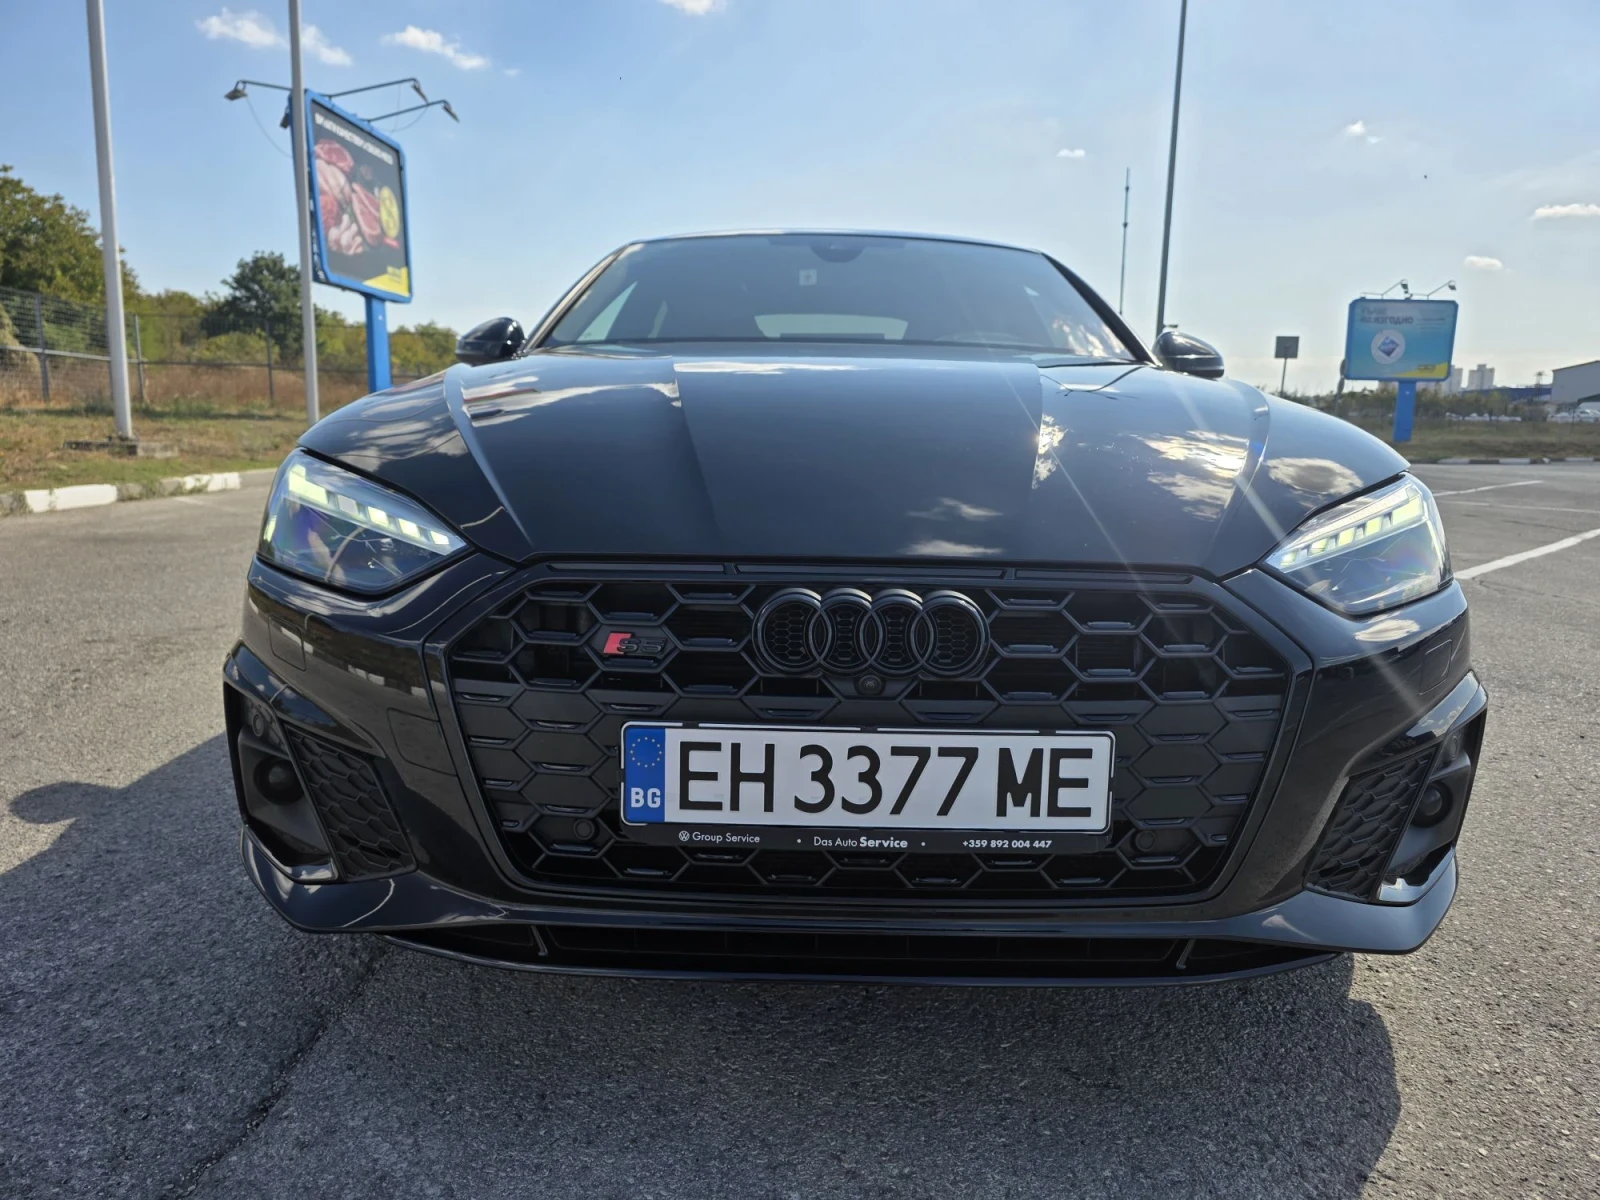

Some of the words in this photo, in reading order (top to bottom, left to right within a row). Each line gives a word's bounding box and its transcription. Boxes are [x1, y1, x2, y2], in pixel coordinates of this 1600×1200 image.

[617, 635, 668, 655] S5
[679, 741, 775, 812] EH
[794, 744, 979, 816] 3377
[996, 747, 1093, 817] ME
[630, 787, 661, 808] BG
[692, 831, 723, 844] Group
[725, 832, 760, 843] Service
[813, 836, 833, 846] Das
[834, 837, 858, 847] Auto
[859, 836, 908, 848] Service
[962, 839, 988, 848] +359
[990, 839, 1009, 848] 892
[1011, 840, 1030, 848] 004
[1033, 840, 1052, 848] 447
